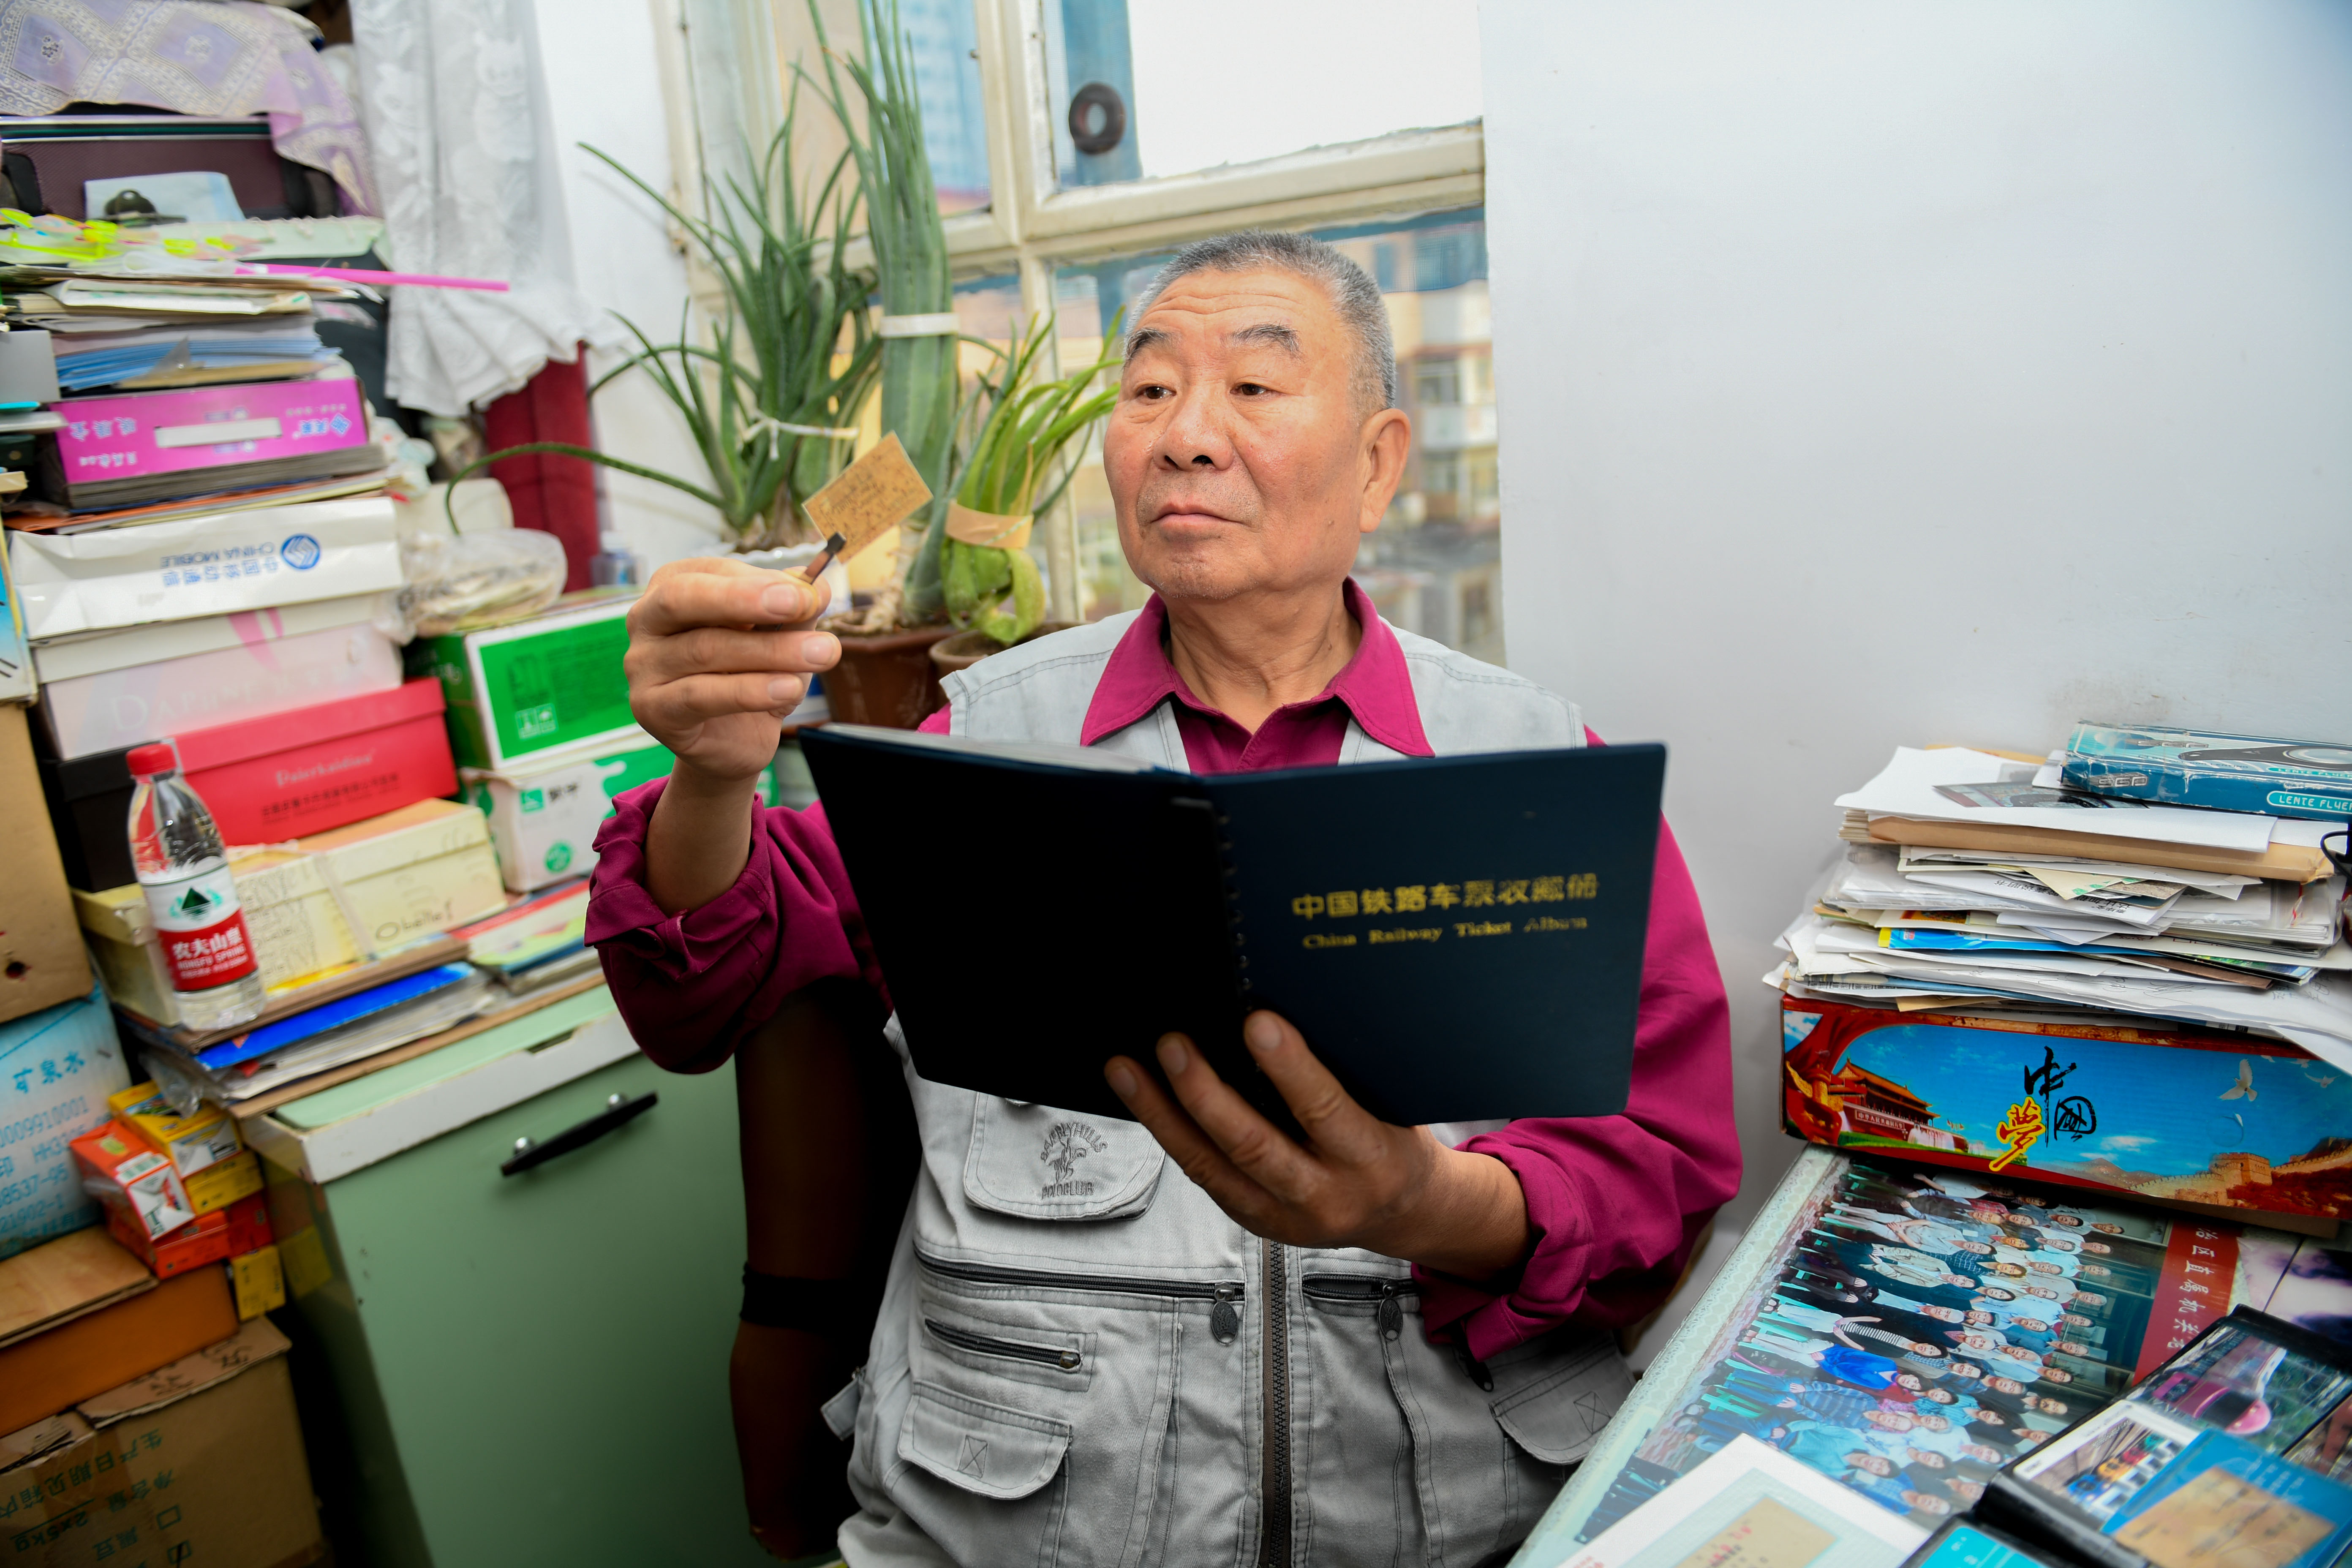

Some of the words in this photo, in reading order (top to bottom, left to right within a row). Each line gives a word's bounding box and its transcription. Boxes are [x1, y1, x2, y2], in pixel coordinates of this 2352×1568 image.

[160, 550, 220, 569] MOBILE
[223, 542, 275, 561] CHINA
[163, 556, 279, 587] 中国移动通信
[2279, 795, 2315, 807] LENTE
[1291, 872, 1600, 920] 中国铁路车票收藏册
[173, 925, 243, 960] 农夫山泉
[1302, 933, 1357, 949] China
[1368, 926, 1443, 944] Railway
[1453, 920, 1512, 938] Ticket
[1524, 917, 1588, 932] Album
[215, 944, 246, 963] SPRING
[0, 1428, 163, 1519] 生产日期见箱内
